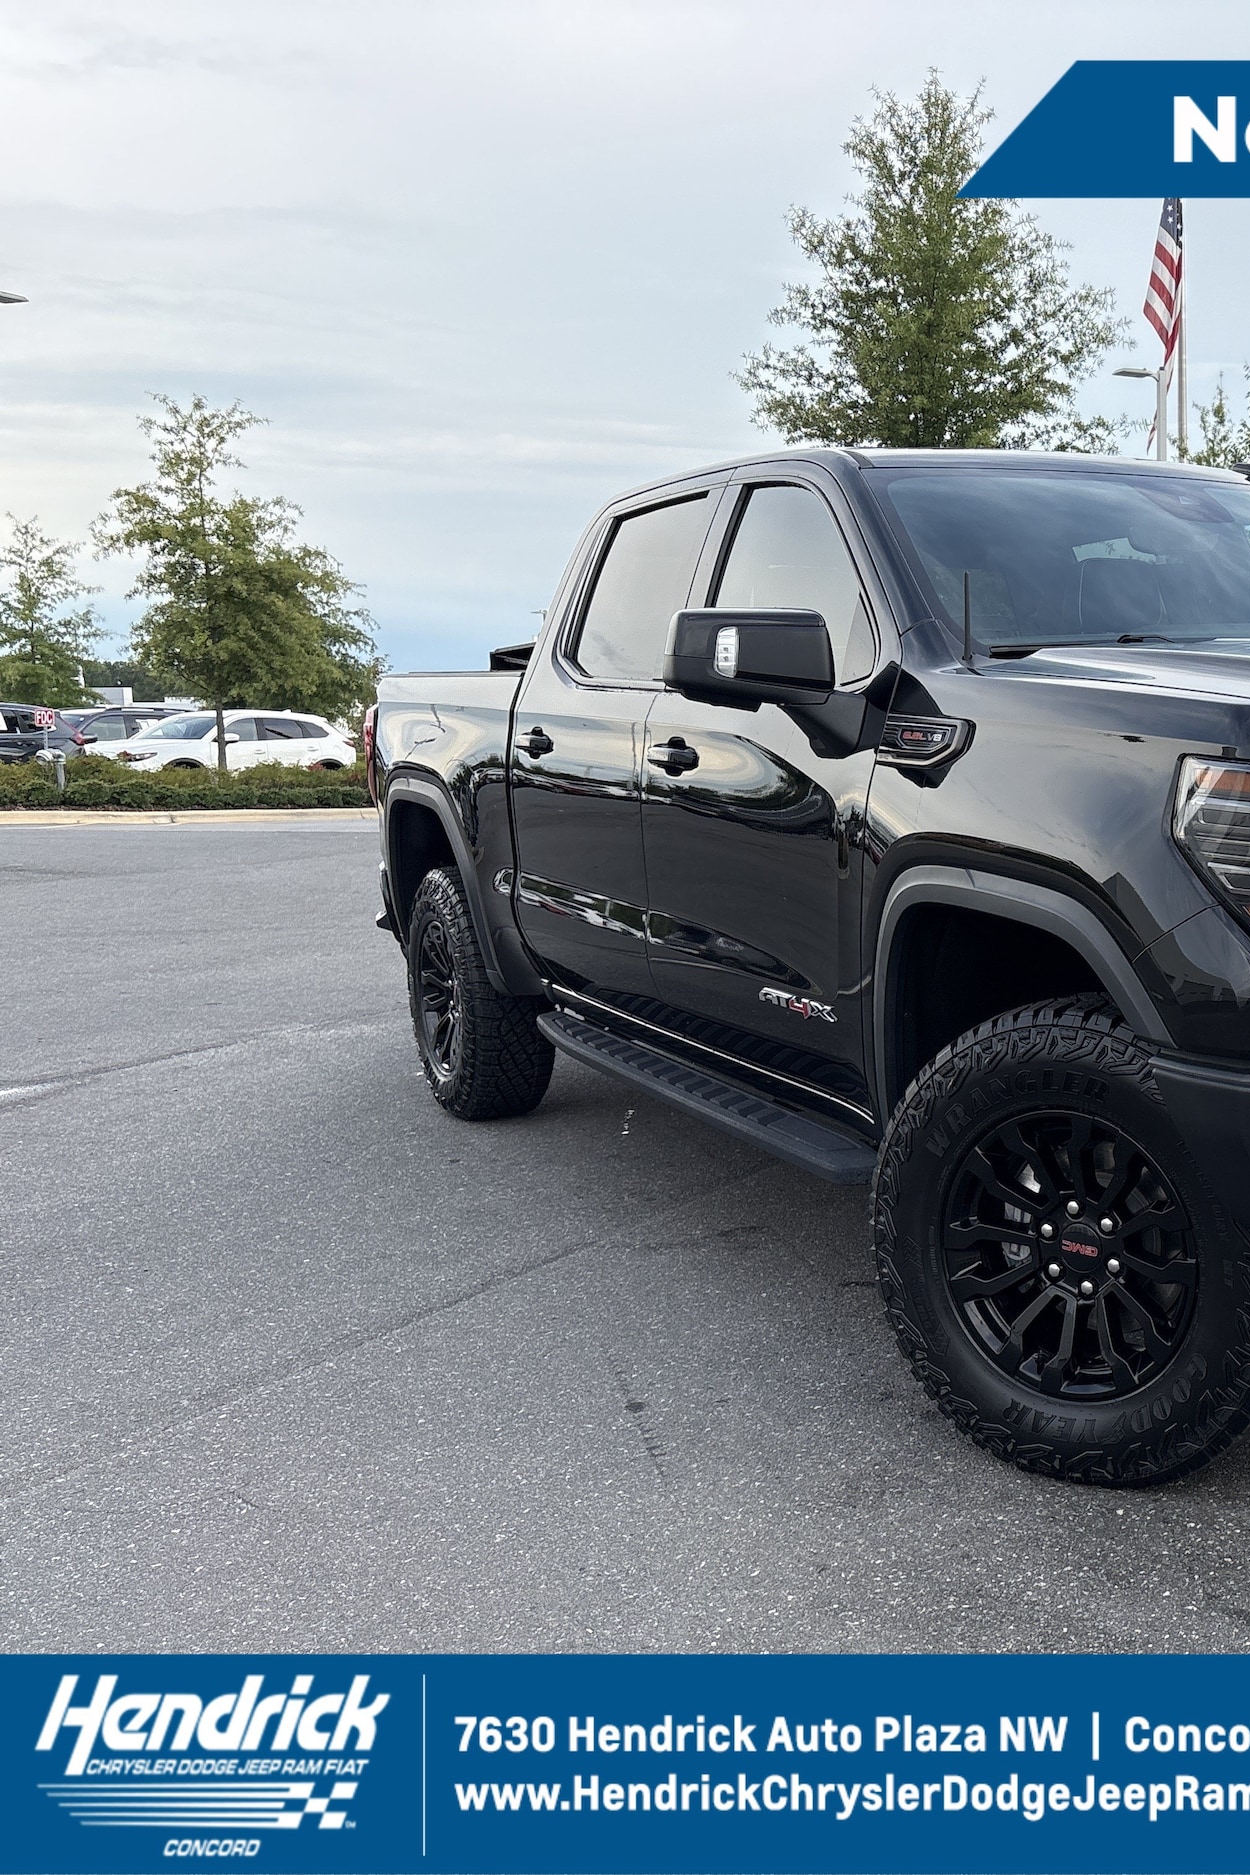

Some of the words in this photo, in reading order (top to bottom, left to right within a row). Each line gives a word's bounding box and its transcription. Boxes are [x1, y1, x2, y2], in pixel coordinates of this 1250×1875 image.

[36, 710, 53, 724] FDC
[758, 986, 838, 1022] AT4X
[925, 1067, 1111, 1158] WRANGLER
[1061, 1239, 1098, 1257] GMC
